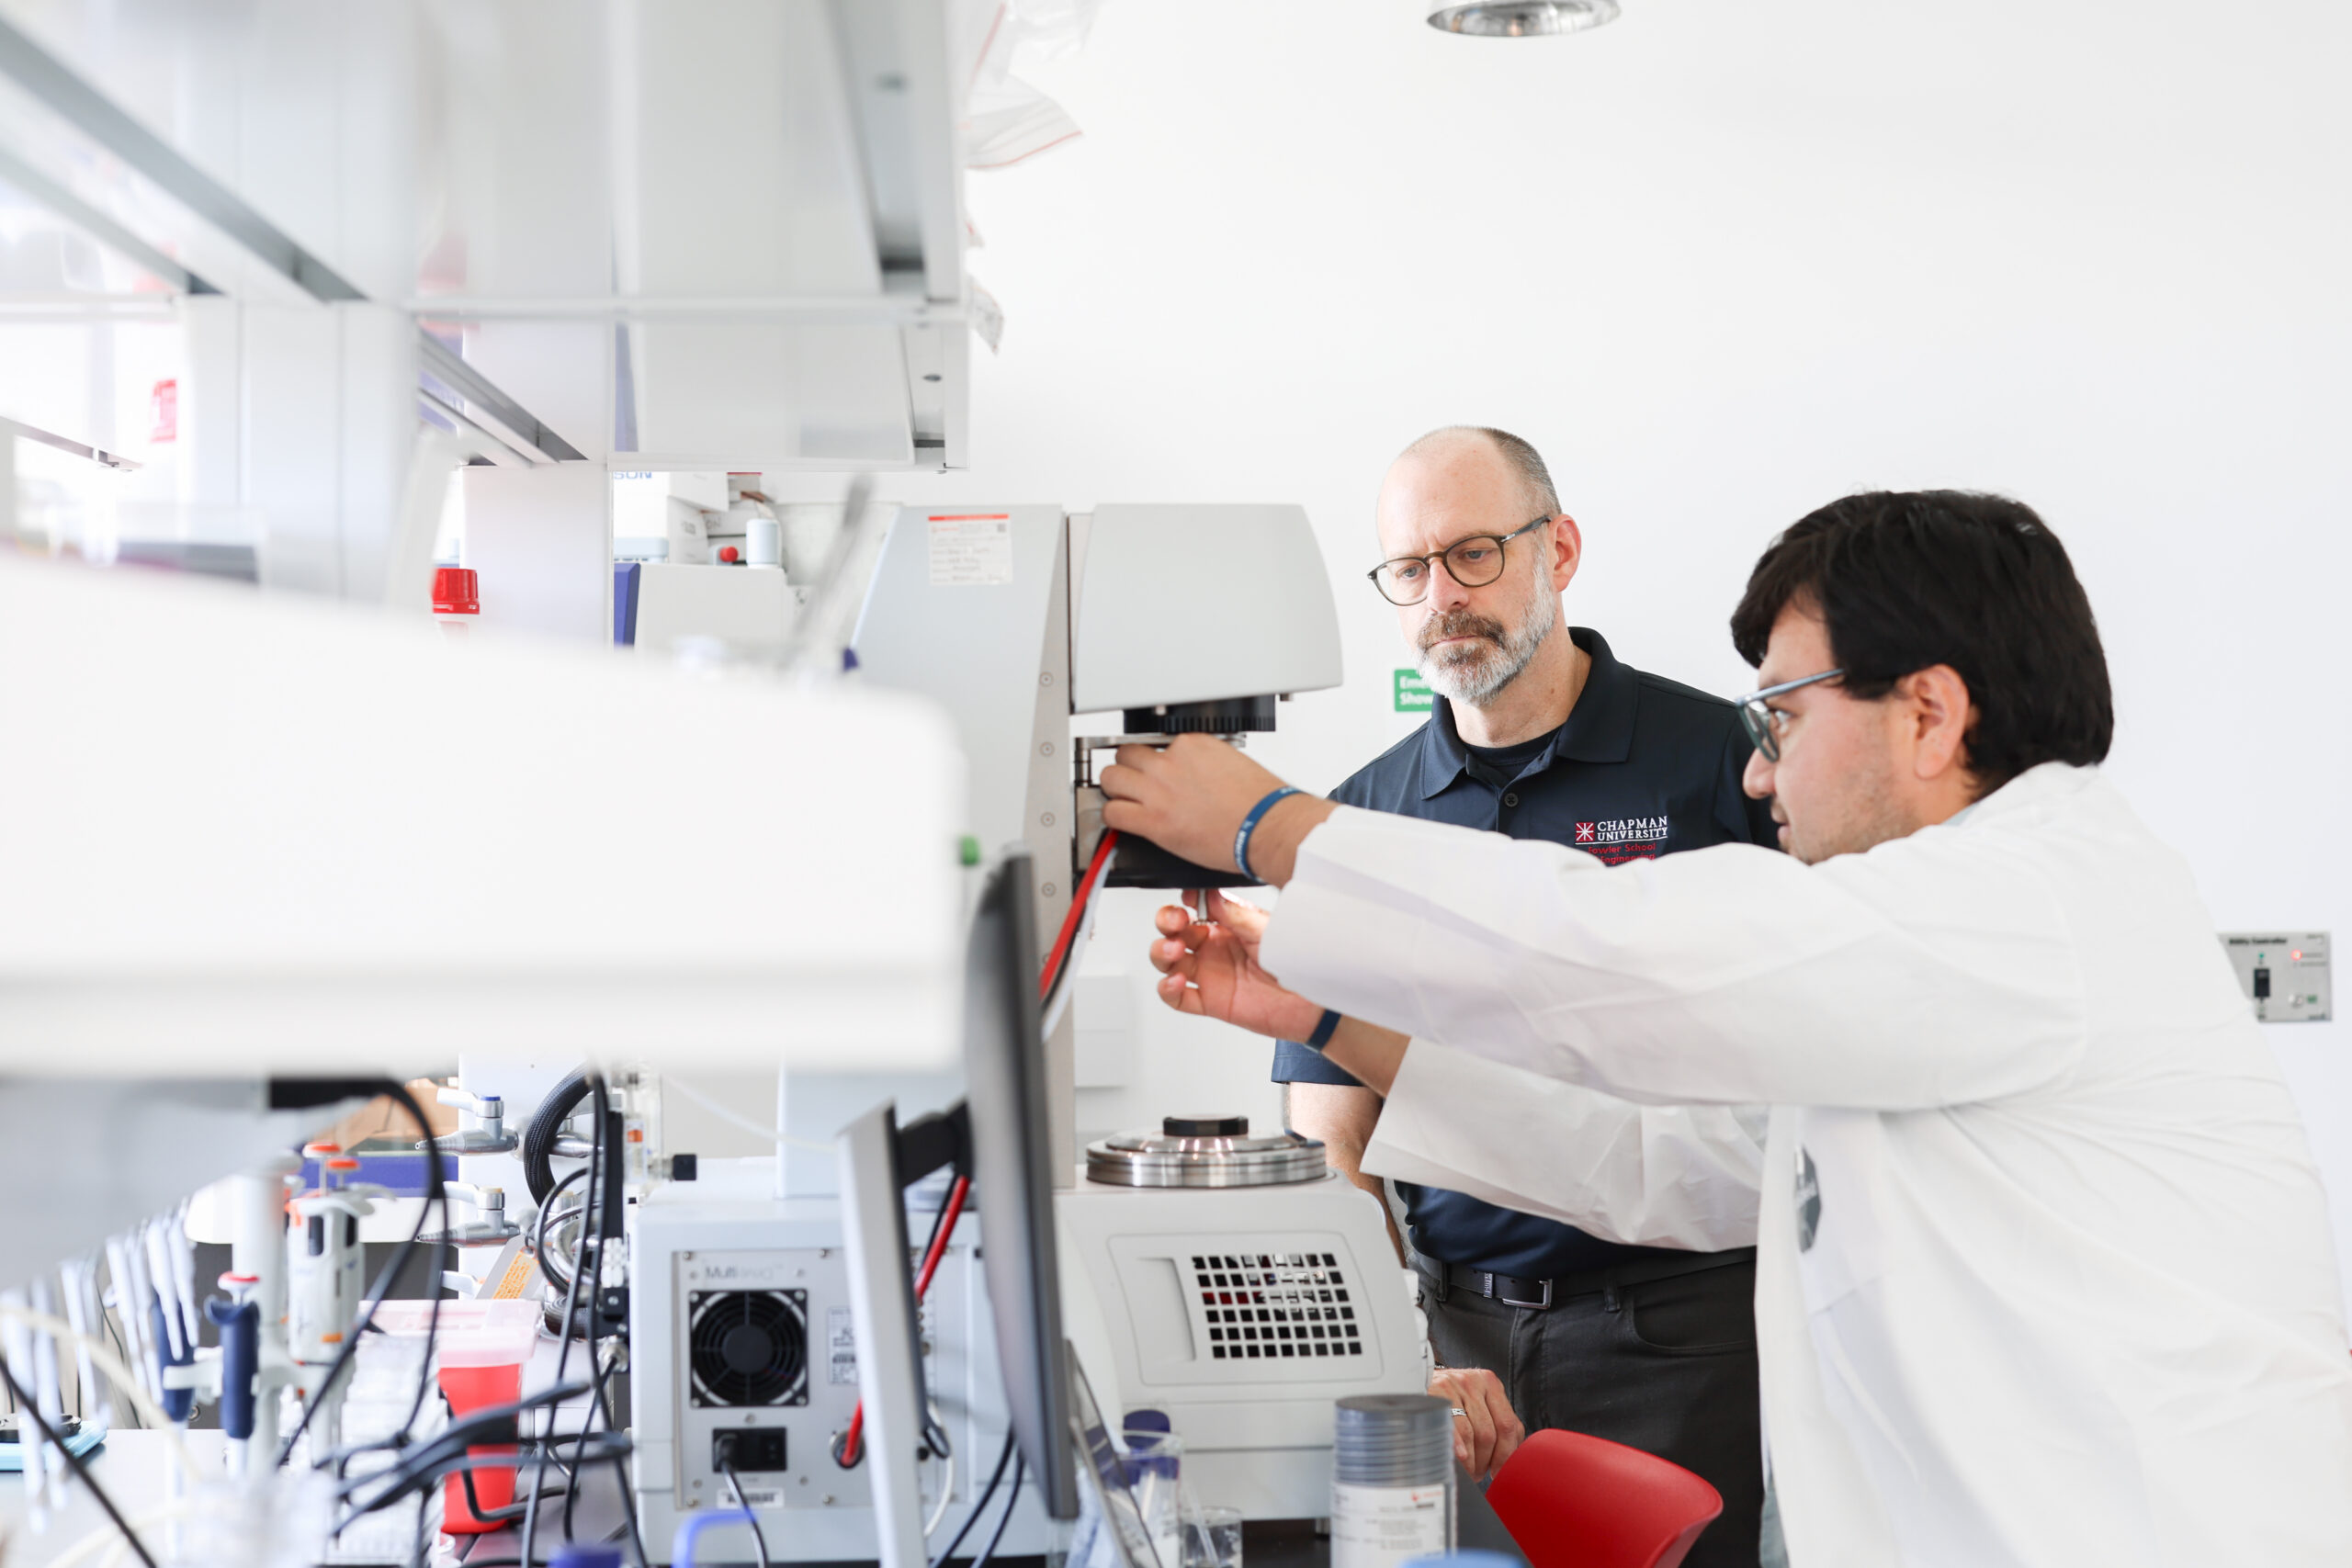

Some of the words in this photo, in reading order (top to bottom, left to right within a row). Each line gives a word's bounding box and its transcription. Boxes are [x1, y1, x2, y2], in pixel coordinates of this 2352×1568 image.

[1597, 816, 1668, 831] CHAPMAN
[1597, 827, 1668, 841] UNIVERSITY
[1588, 845, 1622, 854] Fowler
[1624, 842, 1656, 852] School
